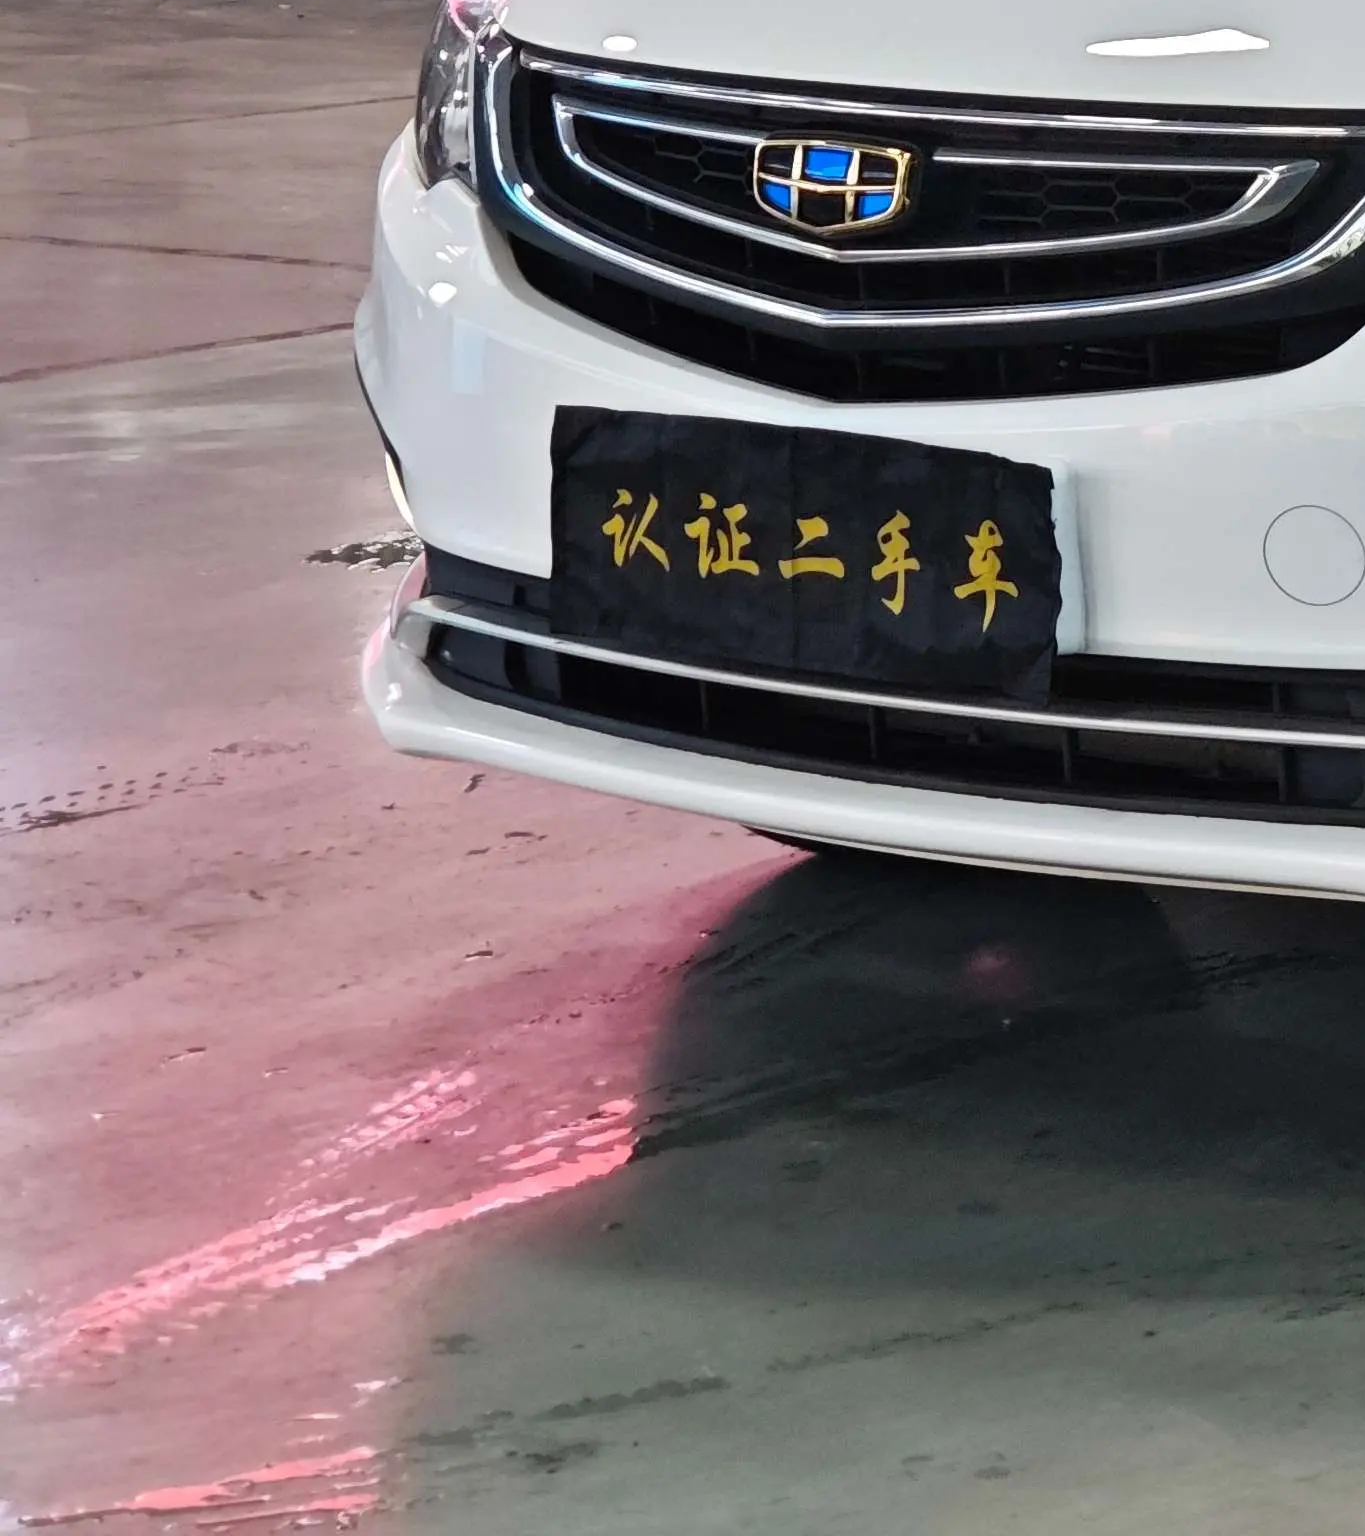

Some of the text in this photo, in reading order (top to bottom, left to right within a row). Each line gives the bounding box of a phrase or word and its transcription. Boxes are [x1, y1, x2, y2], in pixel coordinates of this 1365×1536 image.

[601, 489, 1020, 633] 认证二手车
